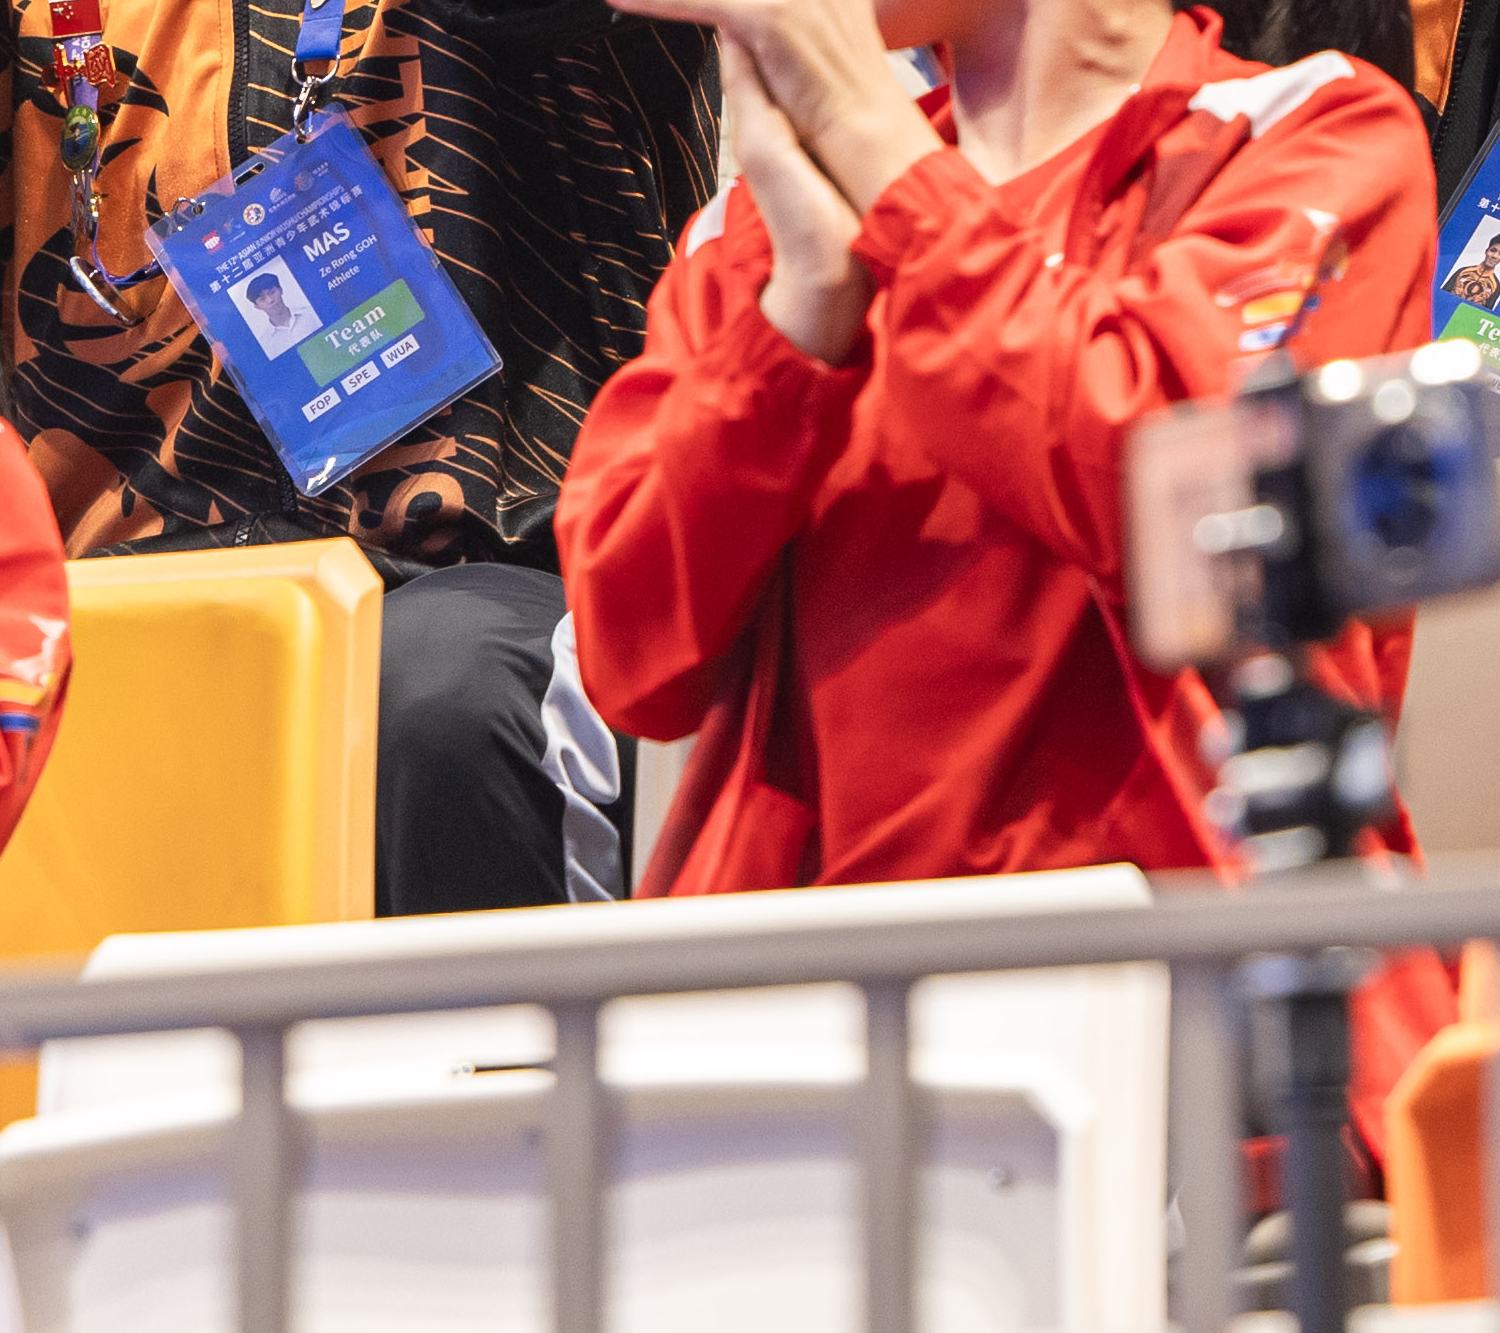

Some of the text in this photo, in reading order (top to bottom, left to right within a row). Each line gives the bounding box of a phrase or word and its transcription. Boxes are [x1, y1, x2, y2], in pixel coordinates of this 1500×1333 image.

[237, 243, 257, 260] ASIAN
[303, 221, 350, 262] MAS
[319, 234, 378, 278] Ze Rong GOH
[327, 265, 360, 291] Athlete
[325, 305, 387, 350] Team
[348, 328, 384, 357] 代表队
[309, 341, 414, 415] FOP SPE WUA
